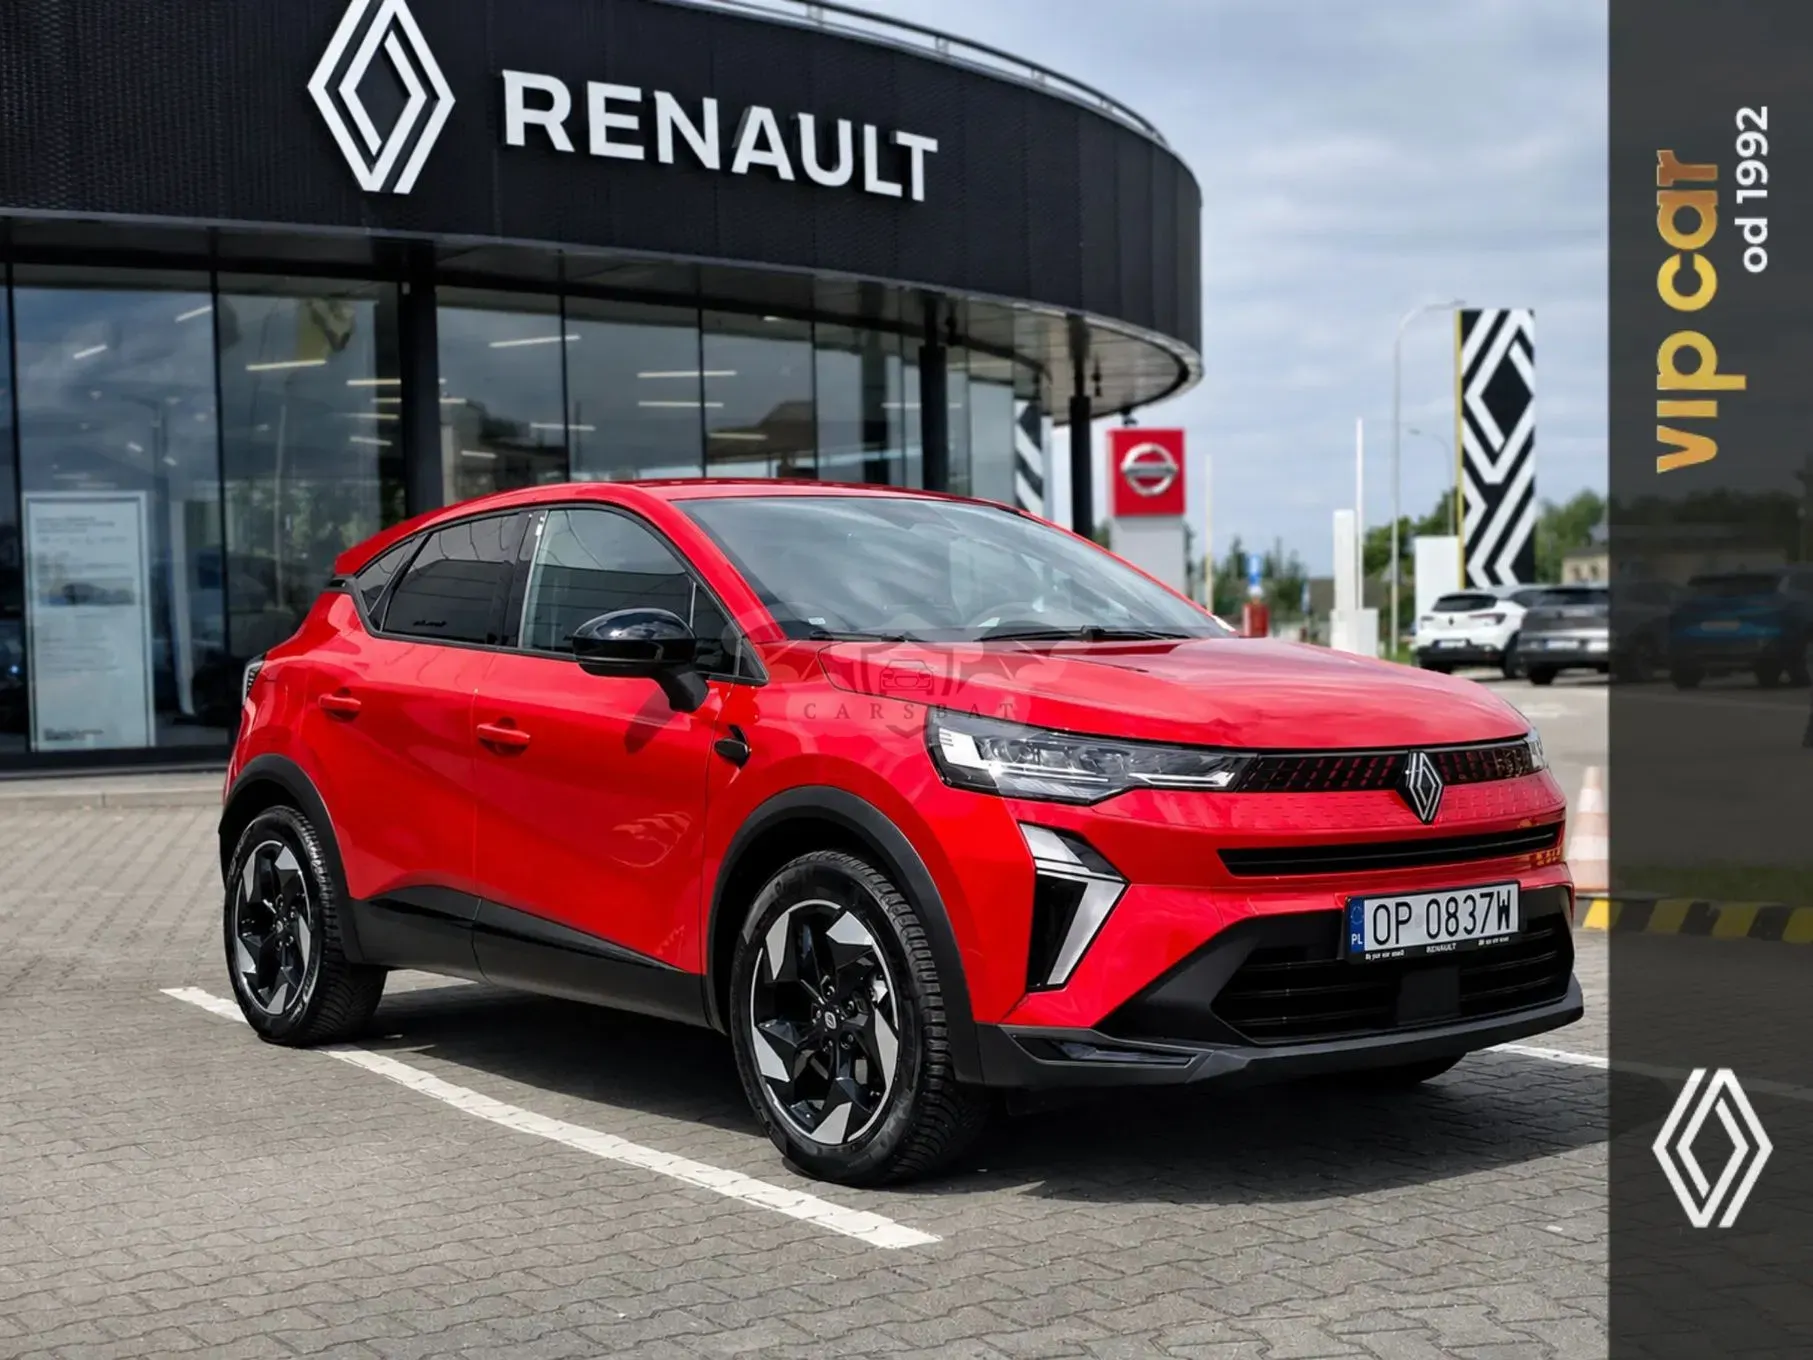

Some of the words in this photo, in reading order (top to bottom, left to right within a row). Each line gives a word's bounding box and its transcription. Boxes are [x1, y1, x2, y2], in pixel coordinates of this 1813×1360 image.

[502, 69, 938, 202] RENAULT
[1351, 933, 1364, 945] PL
[1373, 901, 1412, 945] OP
[1425, 890, 1511, 939] 0837W
